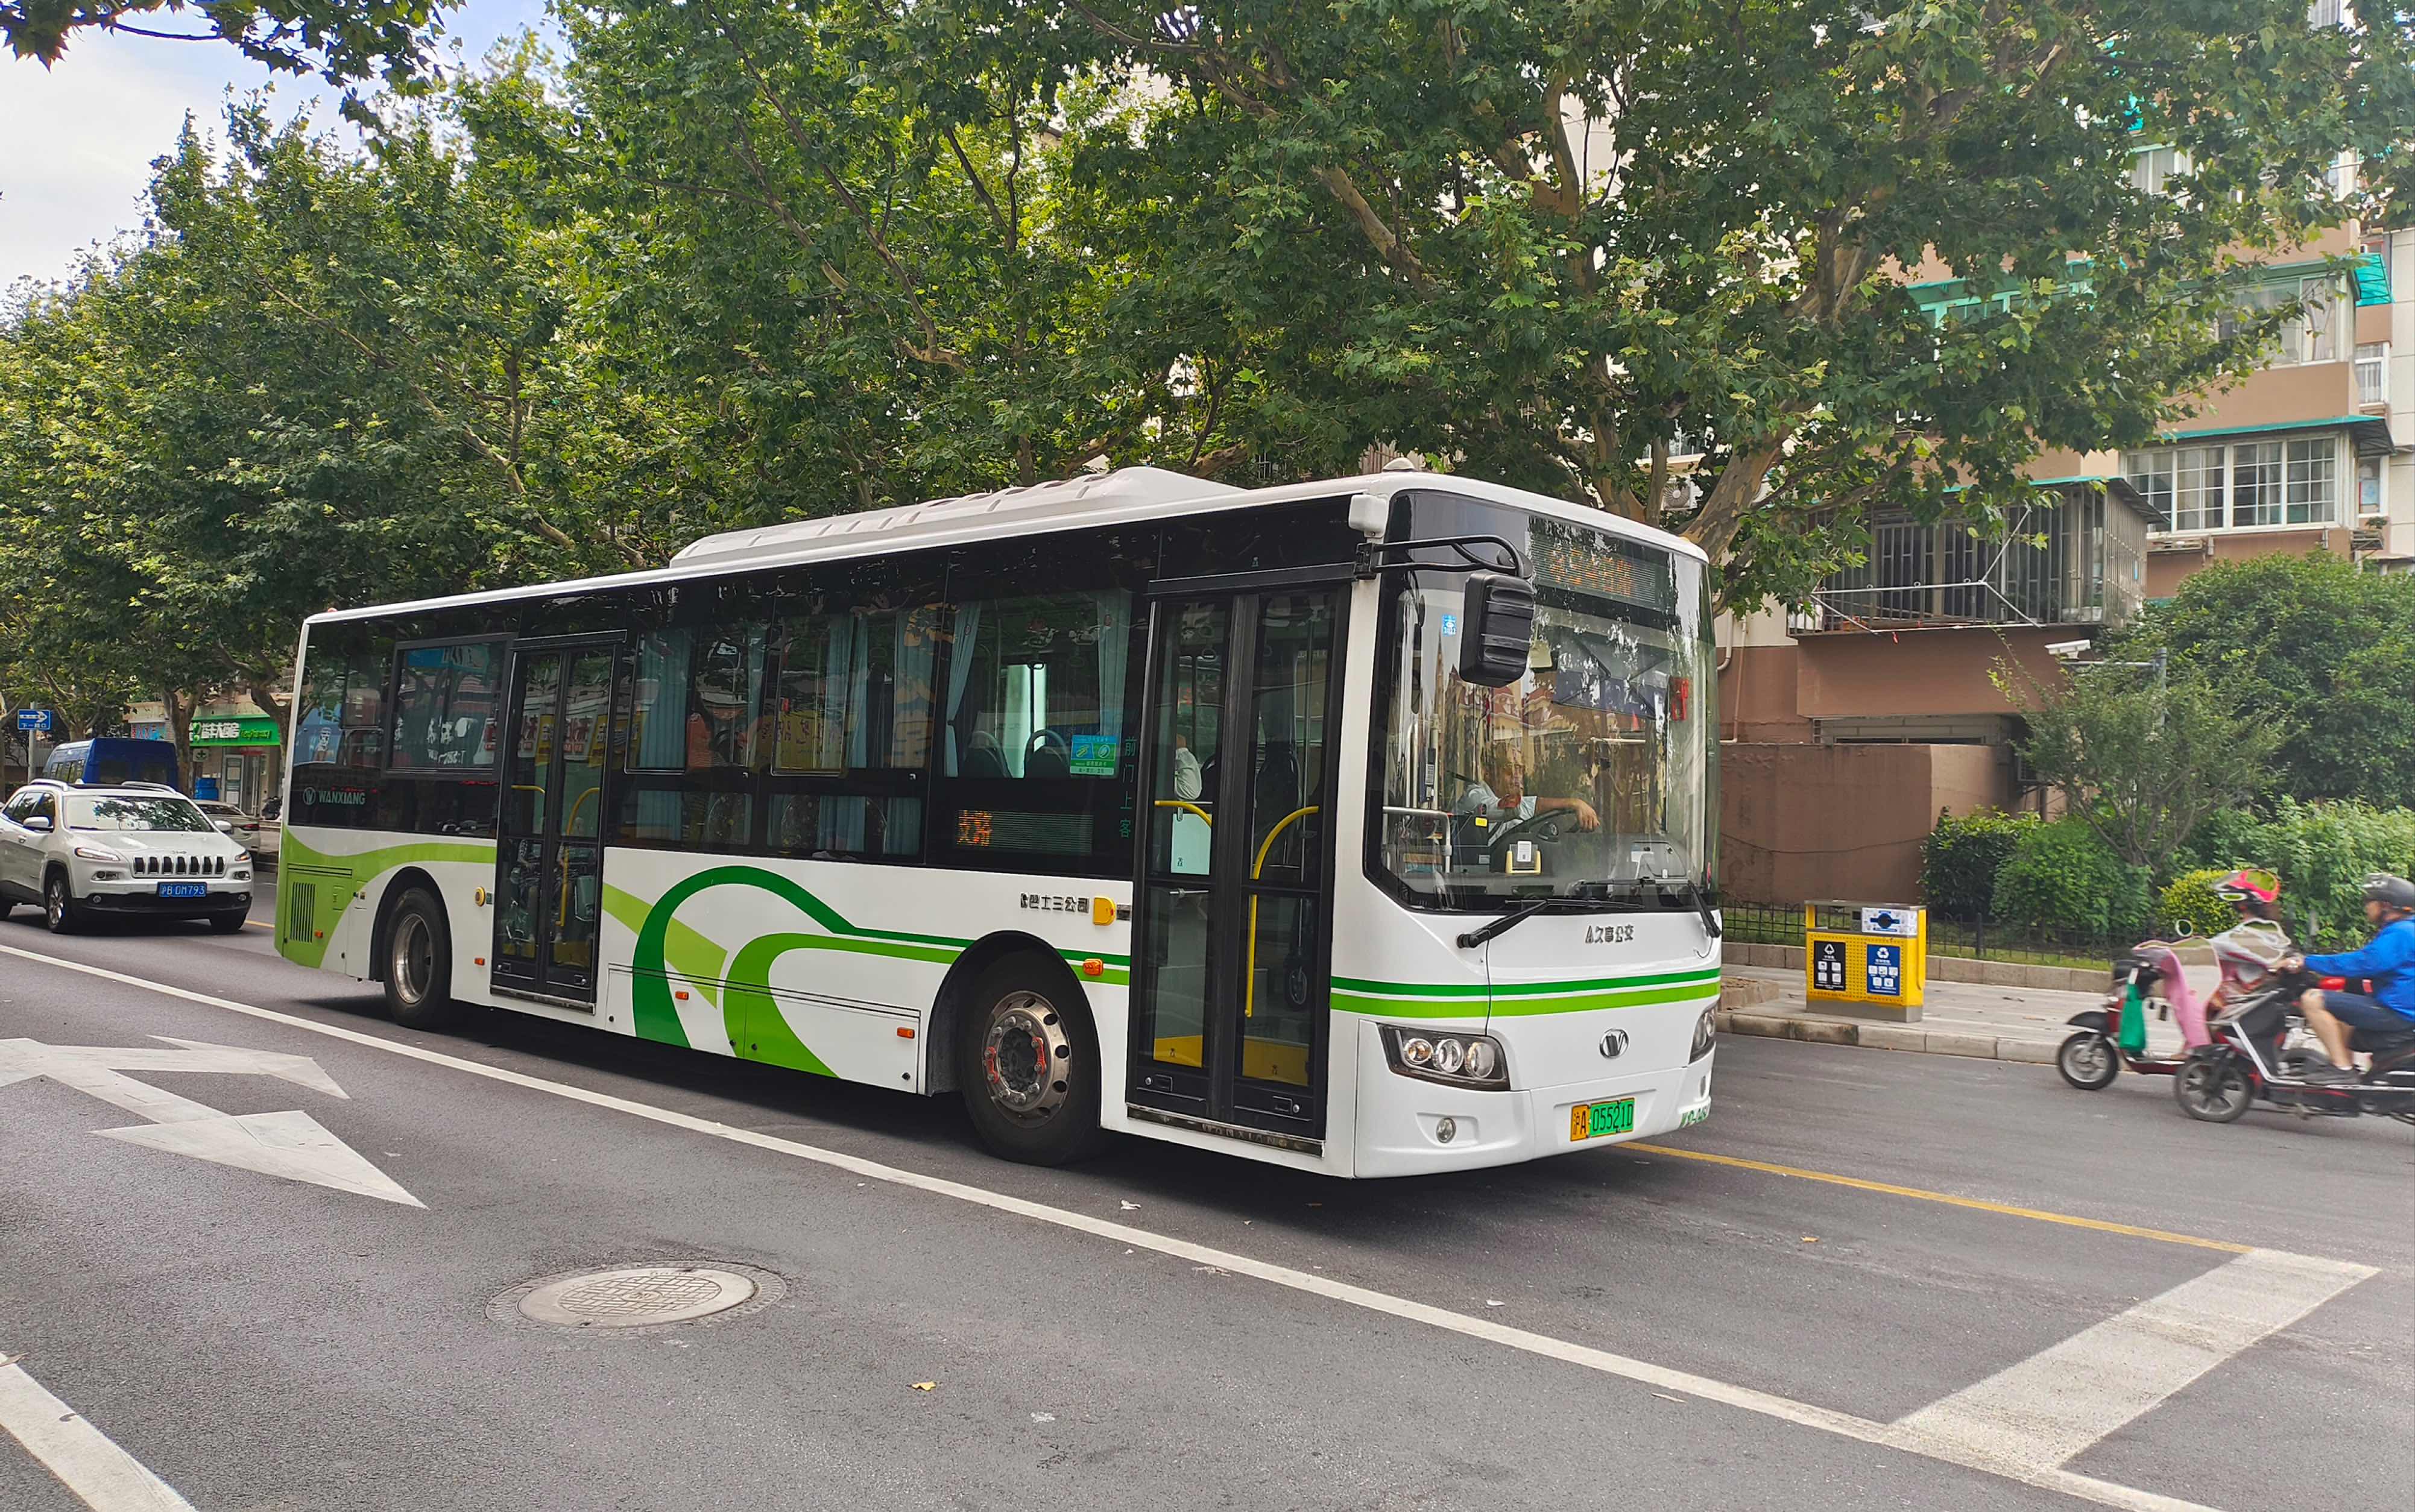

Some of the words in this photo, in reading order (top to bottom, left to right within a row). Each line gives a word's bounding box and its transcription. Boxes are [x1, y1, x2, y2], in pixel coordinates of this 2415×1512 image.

[1119, 736, 1137, 839] 前门上客
[319, 790, 365, 805] WANXIANG
[1029, 895, 1089, 913] 巴士三公司
